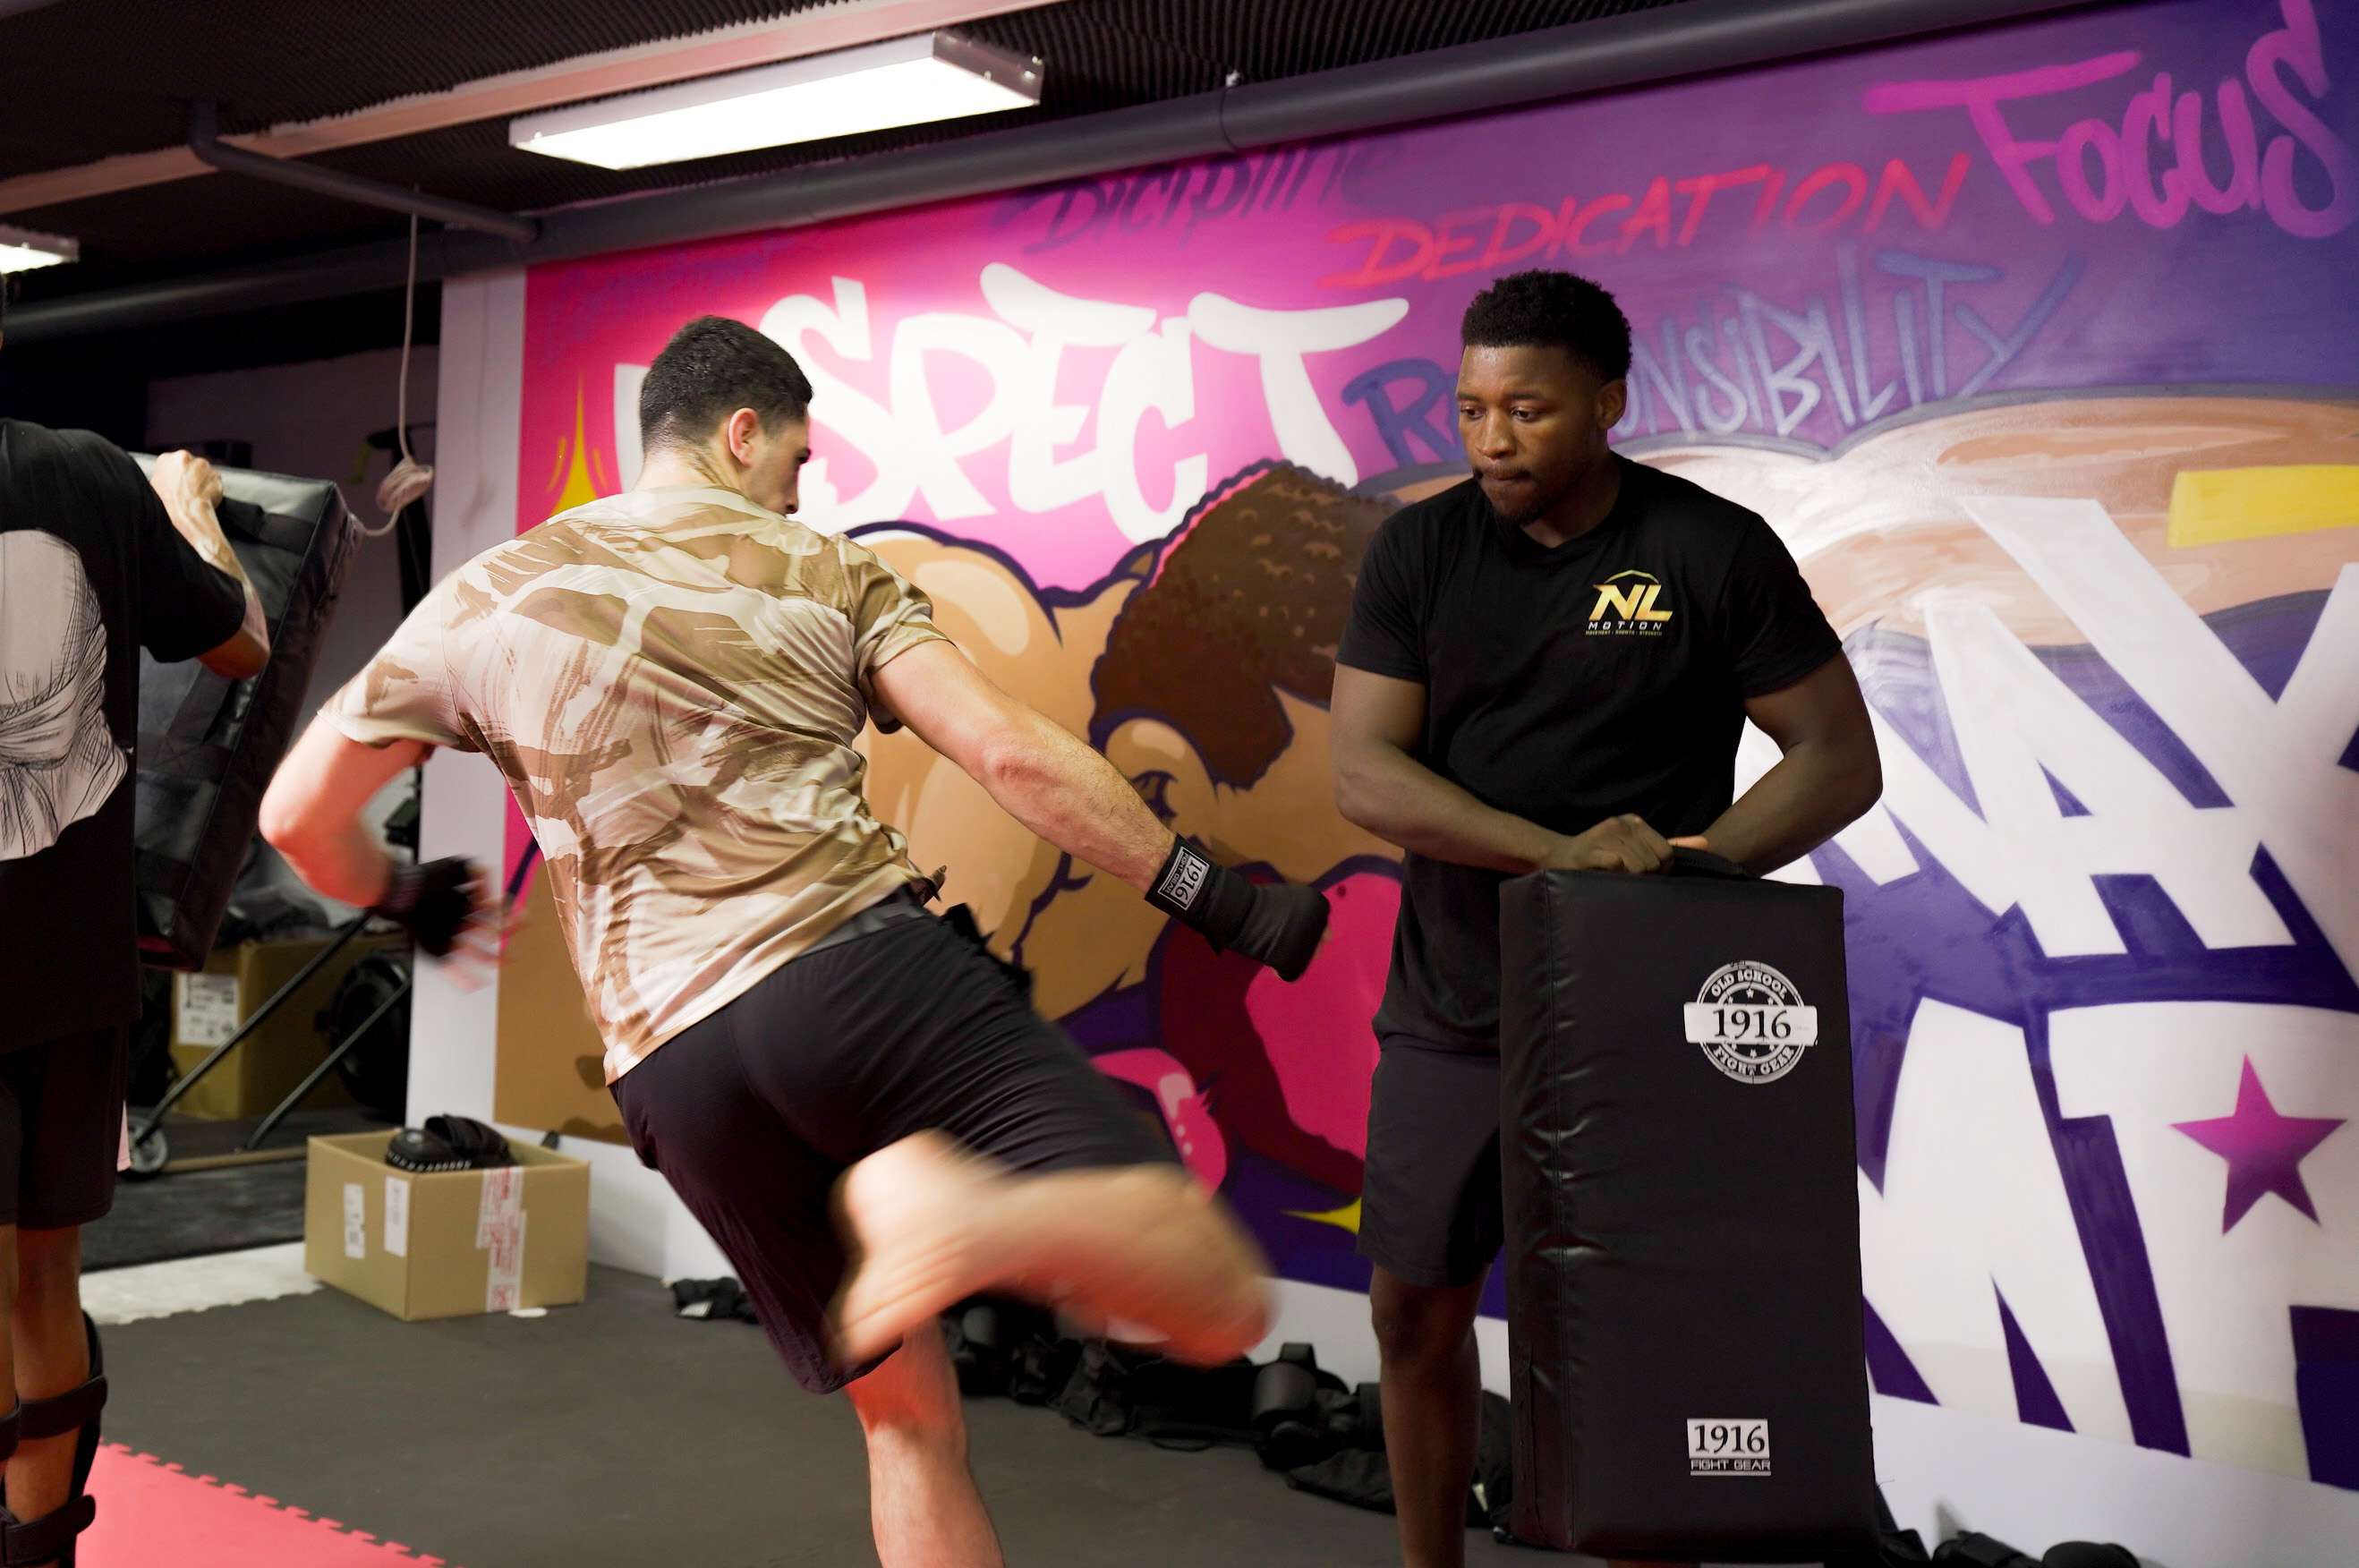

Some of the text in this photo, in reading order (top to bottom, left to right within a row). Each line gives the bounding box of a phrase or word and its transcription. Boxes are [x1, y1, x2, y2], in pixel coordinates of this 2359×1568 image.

[1317, 151, 1971, 290] DEDICATION
[614, 261, 1409, 545] SPECT
[1588, 584, 1673, 622] NL
[1588, 620, 1663, 631] MOTION
[1175, 859, 1202, 900] 1916
[1710, 968, 1790, 1001] OLD SCHOOL
[1712, 1008, 1792, 1041] 1916
[1713, 1044, 1795, 1077] FIGHT GEAR
[1694, 1423, 1766, 1454] 1916
[1690, 1459, 1771, 1471] FIGHT GEAR
